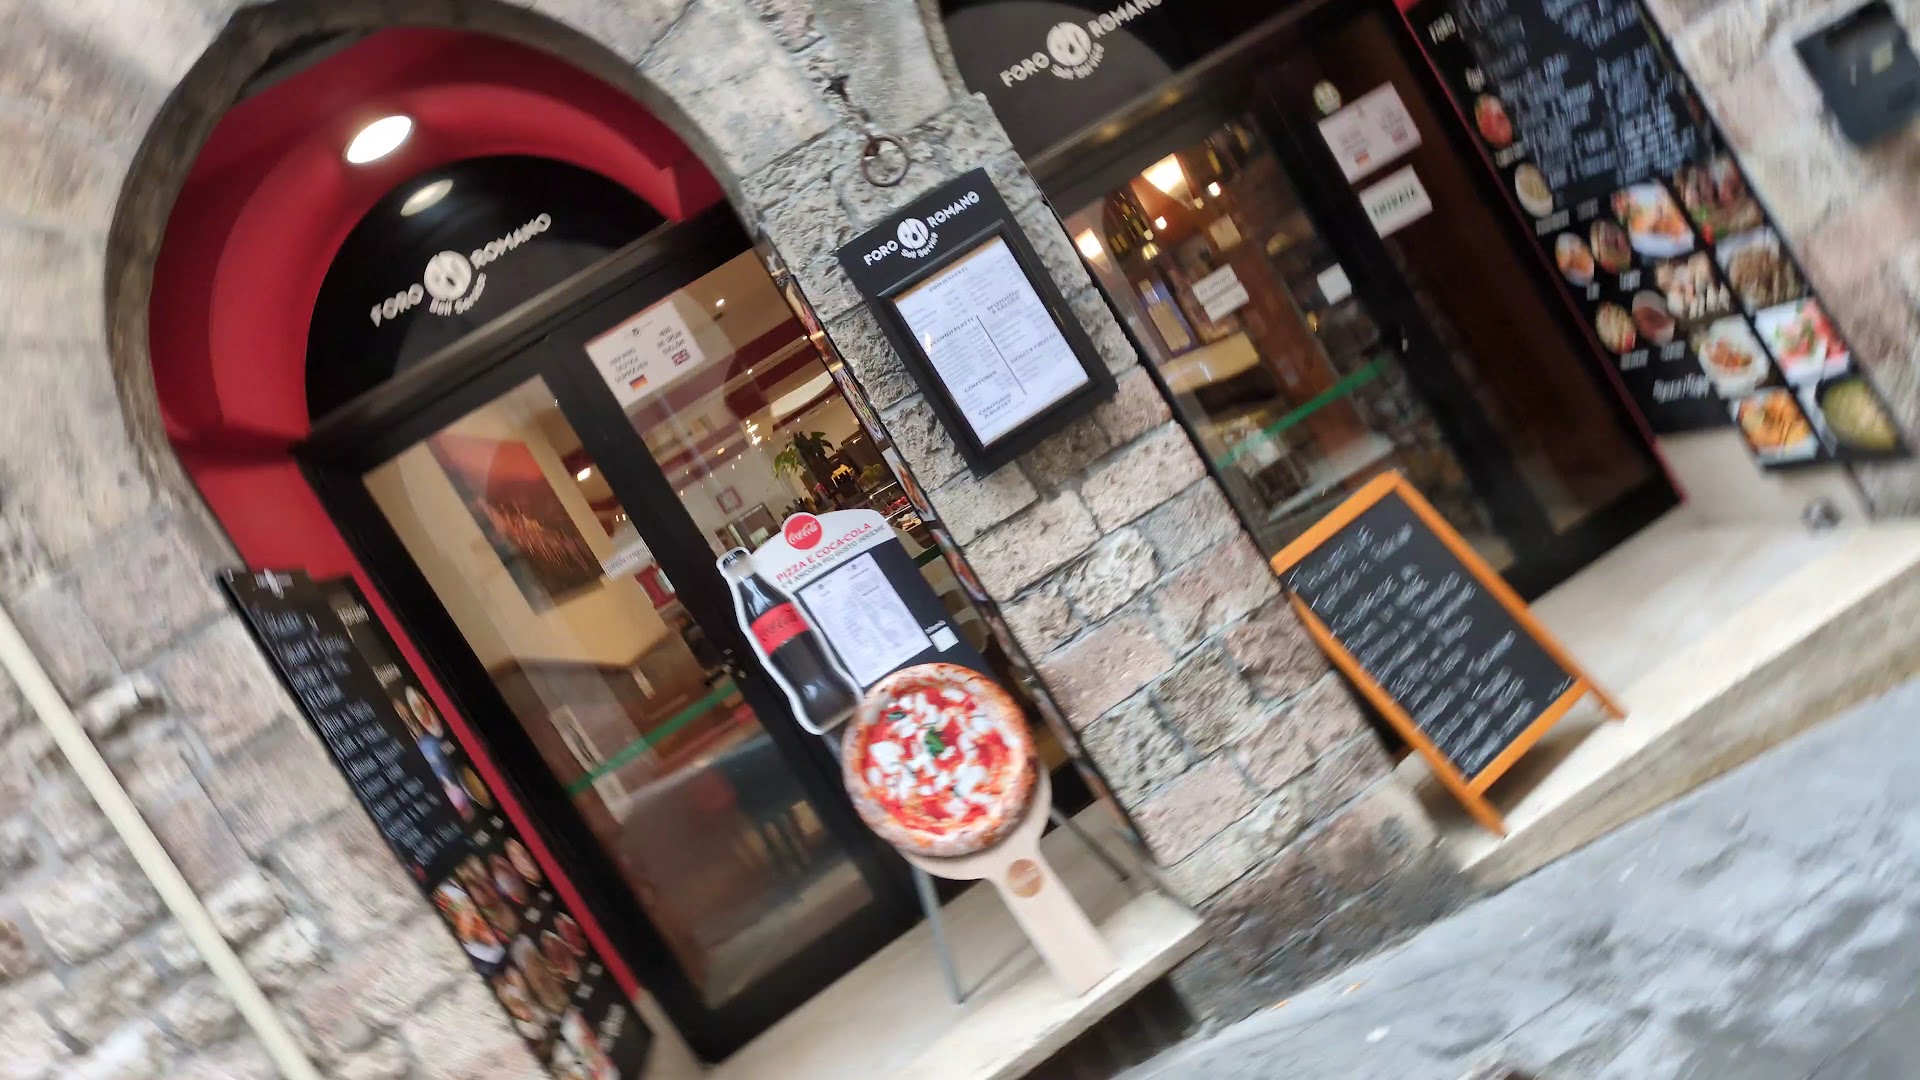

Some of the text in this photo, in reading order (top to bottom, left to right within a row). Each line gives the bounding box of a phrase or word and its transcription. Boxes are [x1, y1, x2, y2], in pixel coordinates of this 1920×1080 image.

[1000, 52, 1049, 87] FORO
[863, 191, 979, 266] FORO ROMANO
[370, 213, 551, 327] FORO ROMANO
[776, 561, 806, 581] PIZZA
[806, 554, 815, 563] E
